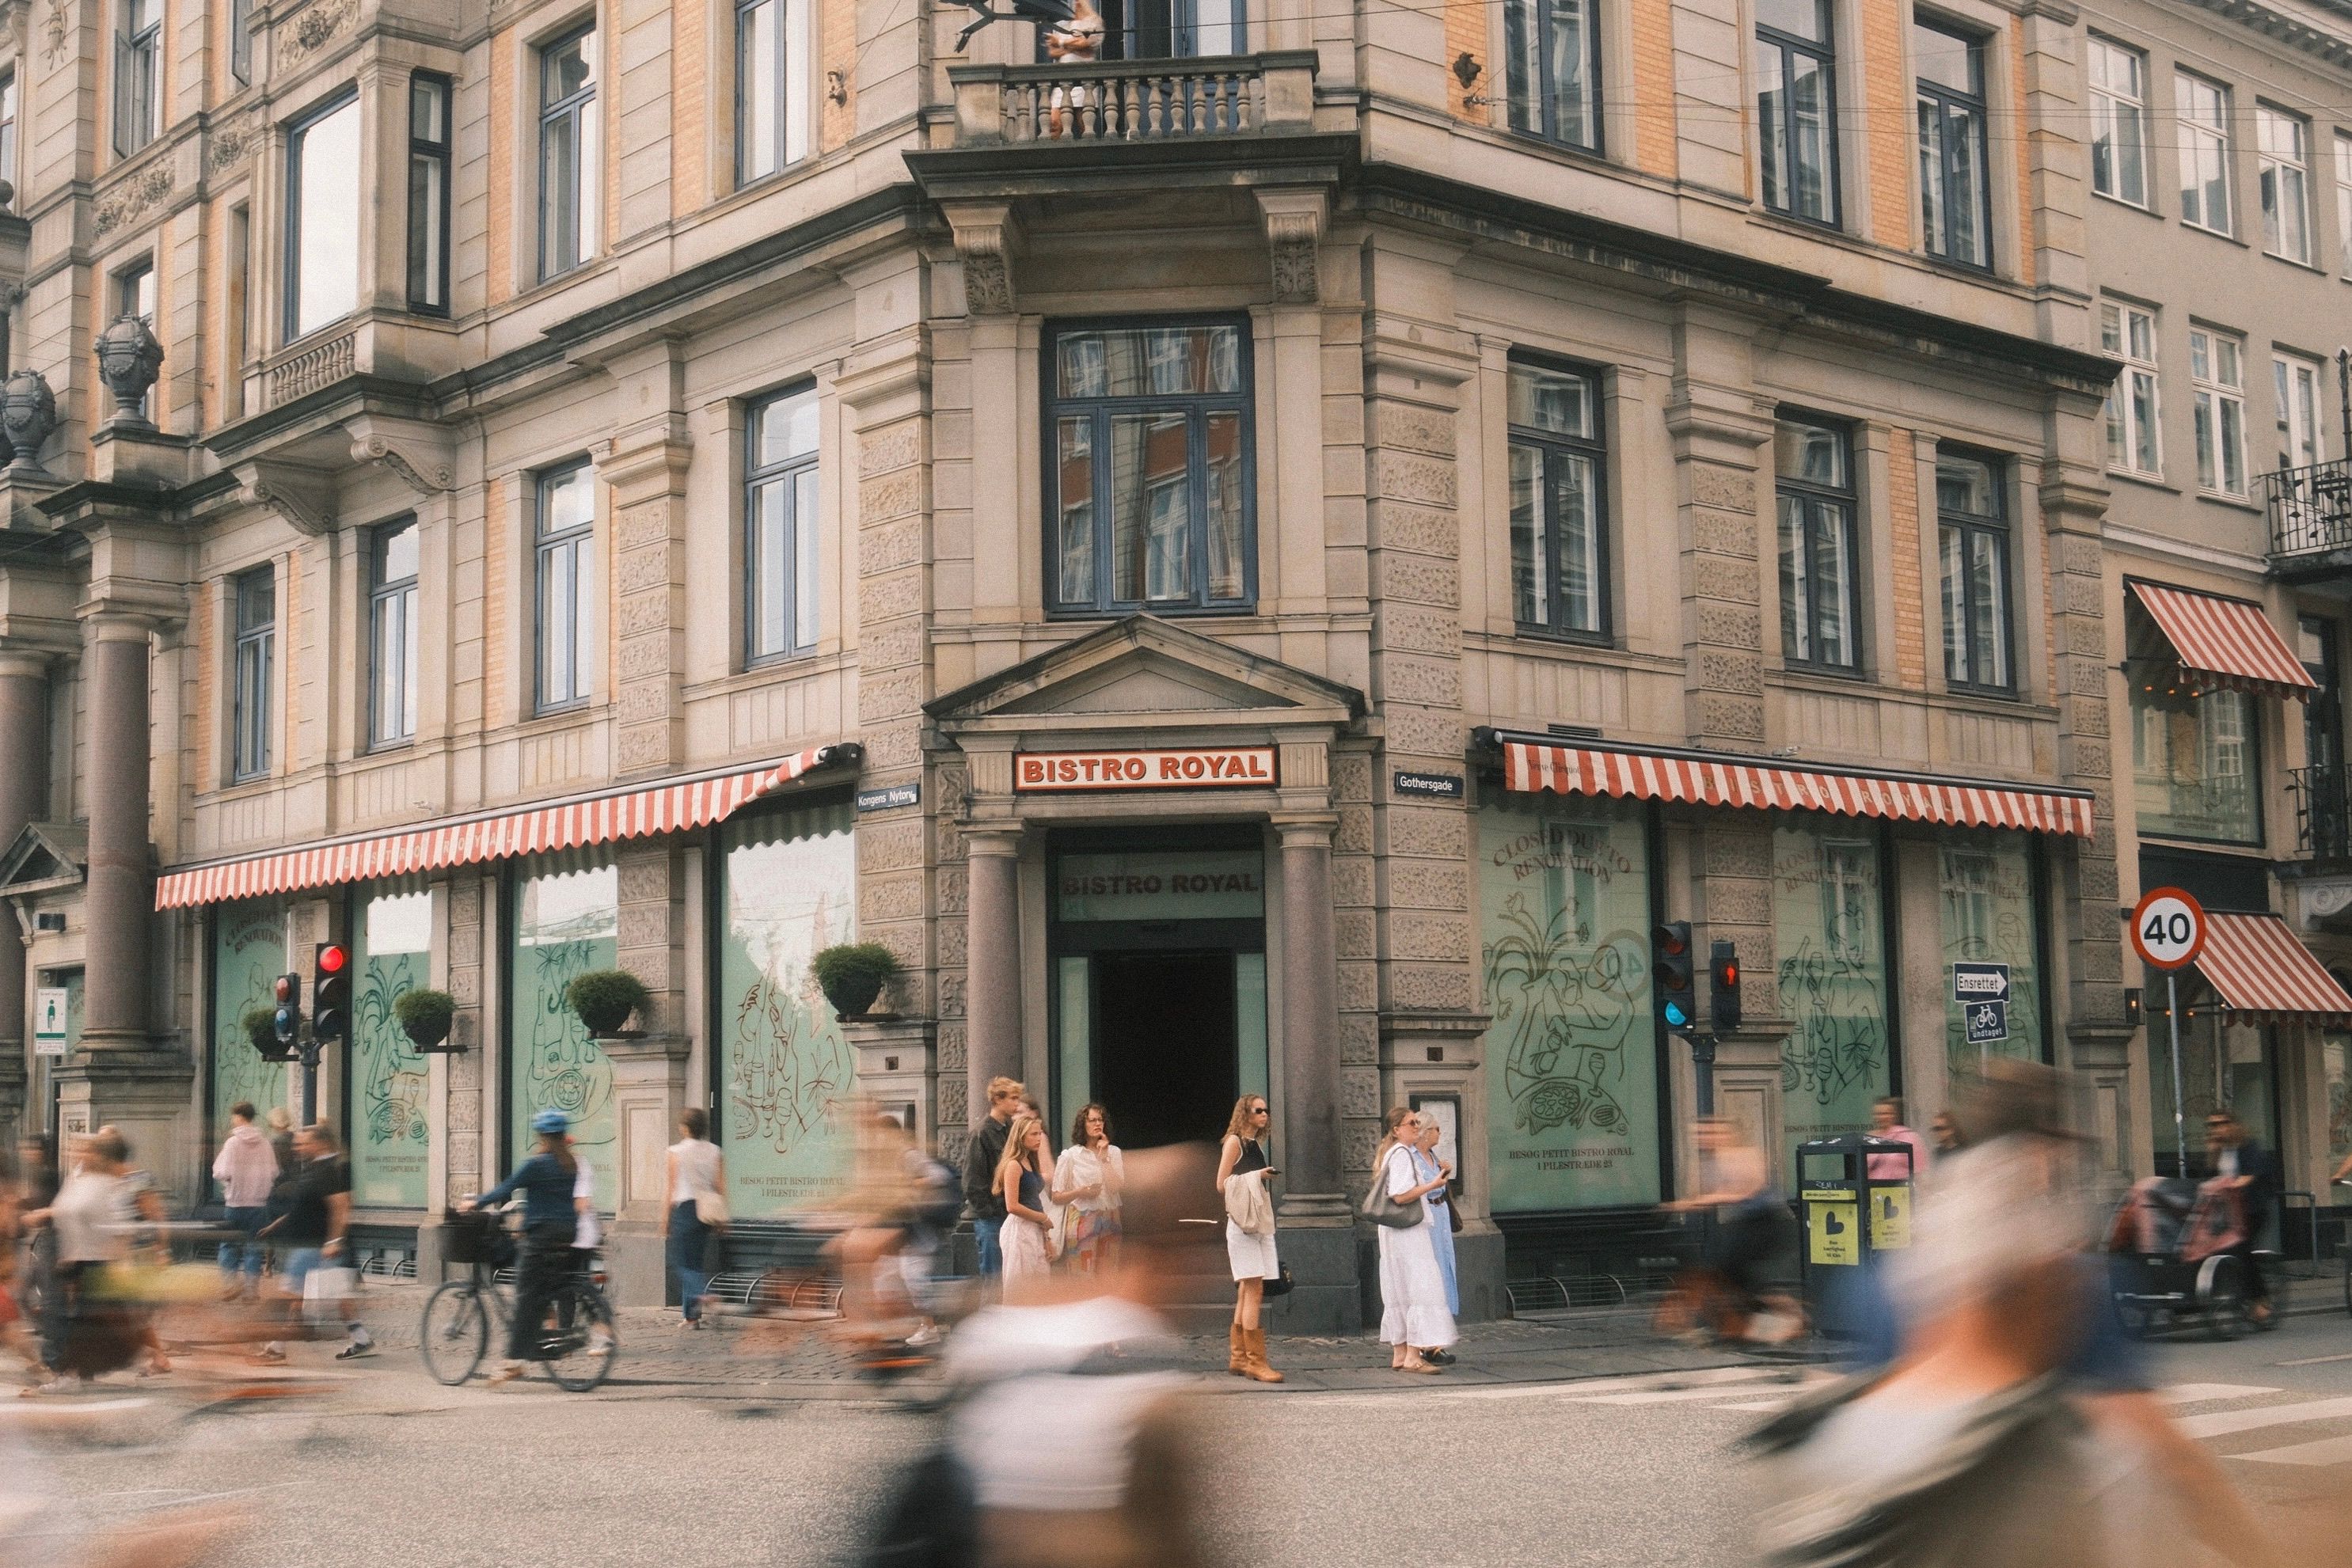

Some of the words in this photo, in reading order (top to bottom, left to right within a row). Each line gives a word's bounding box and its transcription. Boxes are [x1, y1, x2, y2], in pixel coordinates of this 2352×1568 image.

[1023, 757, 1146, 782] BISTRO
[1159, 754, 1267, 780] ROYAL
[1400, 776, 1453, 792] Gothersgade
[1703, 776, 1830, 799] BISTRO
[1861, 791, 1951, 812] ROYAL
[858, 795, 887, 807] Kongens
[889, 790, 913, 803] Nytorv
[343, 845, 421, 870] BISTRO
[443, 830, 513, 855] ROYAL
[1493, 828, 1564, 867] CLOSED
[1606, 845, 1632, 874] TO
[1513, 852, 1612, 884] RENOVATION
[1063, 875, 1163, 895] BISTRO
[1171, 873, 1260, 893] ROYAL
[2144, 913, 2191, 945] 40
[1959, 976, 1998, 989] Ensrettet
[1972, 1027, 2003, 1038] undtaget
[1543, 1148, 1570, 1159] PETIT
[1571, 1148, 1605, 1158] BISTRO
[1607, 1147, 1634, 1156] ROYAL
[766, 1176, 788, 1186] PETIT
[789, 1176, 819, 1186] BISTRO
